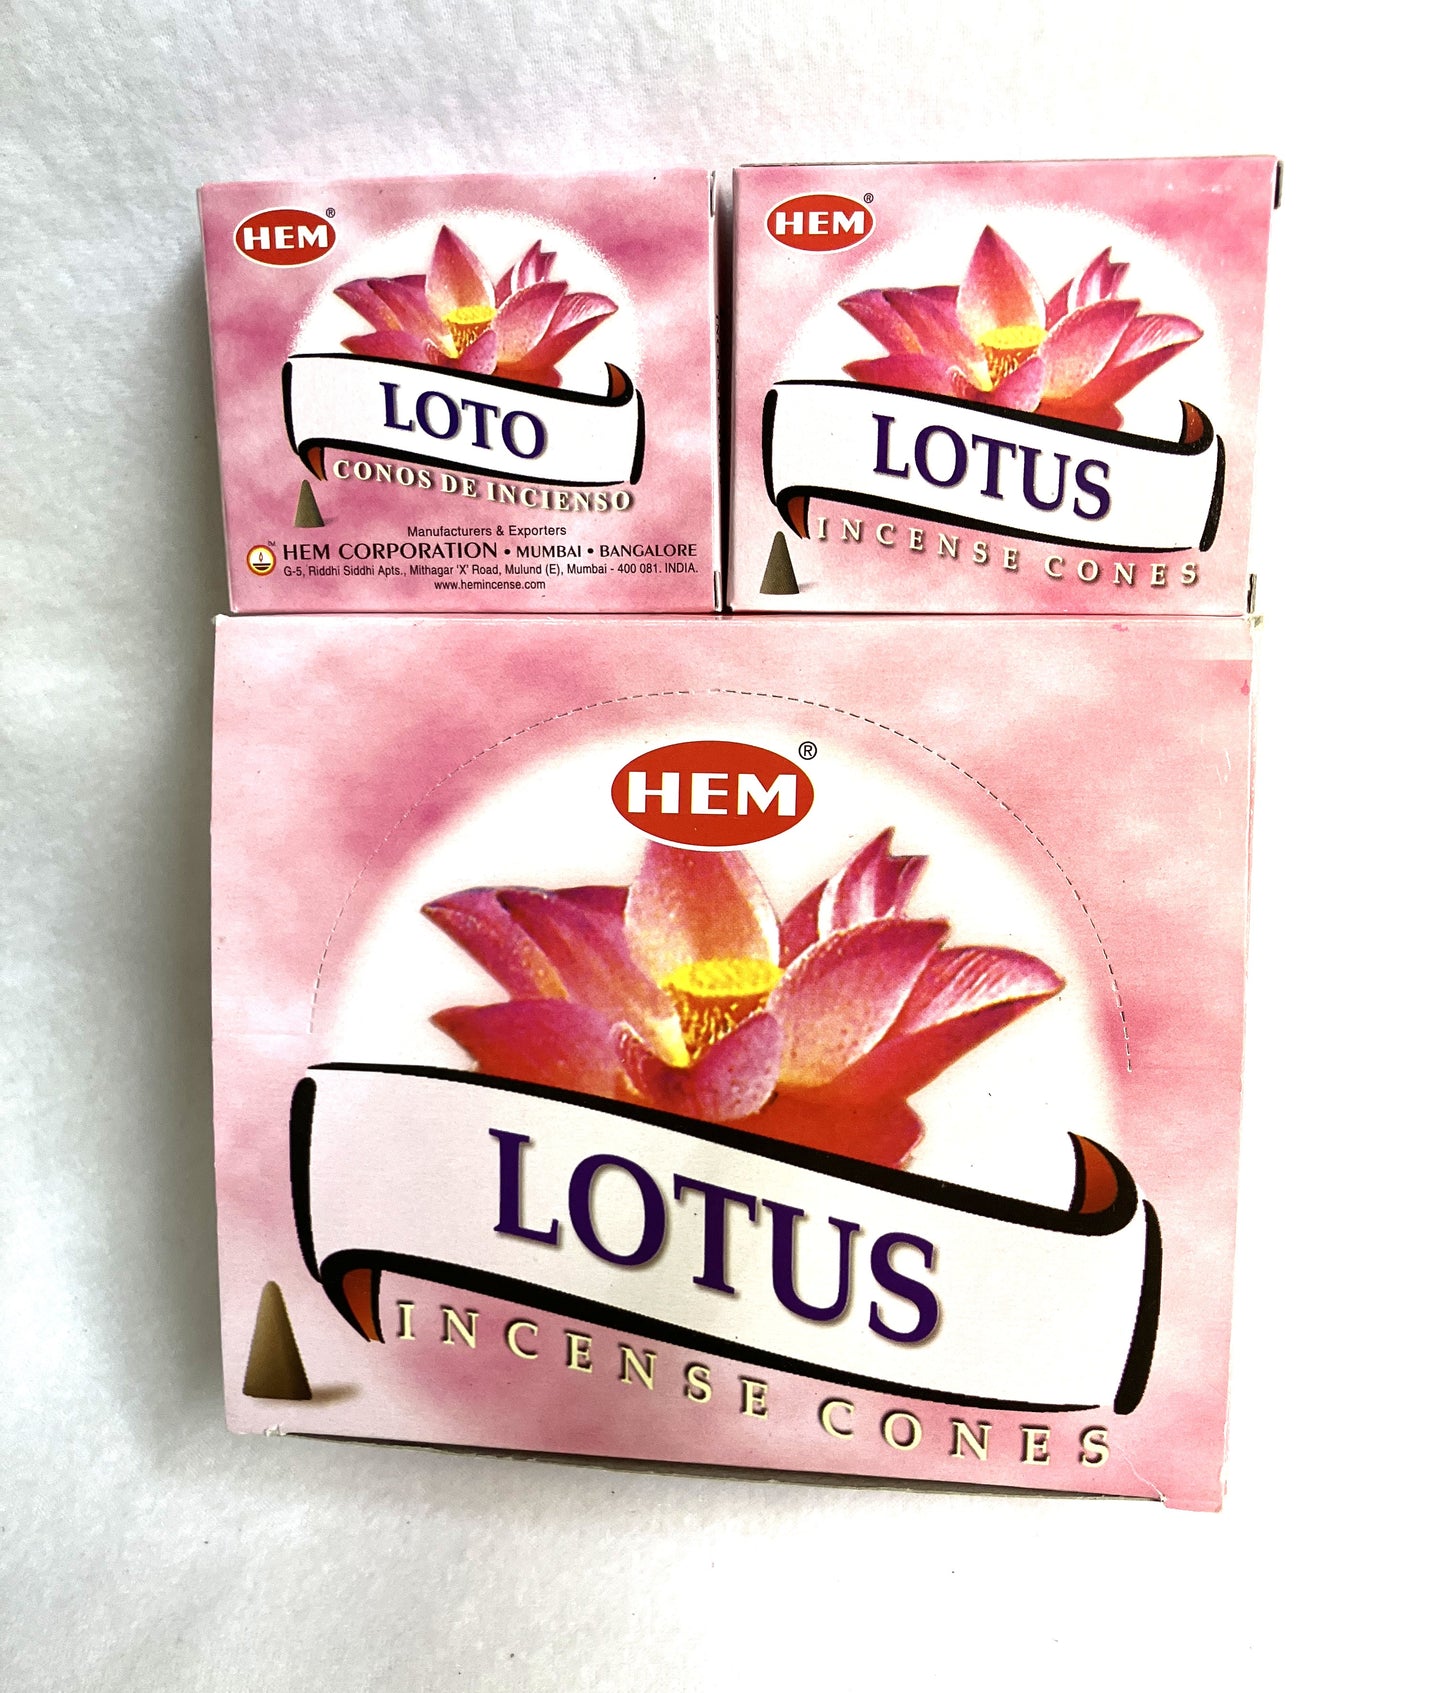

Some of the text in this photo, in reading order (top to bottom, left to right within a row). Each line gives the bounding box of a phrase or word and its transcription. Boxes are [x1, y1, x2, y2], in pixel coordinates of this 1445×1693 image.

[243, 224, 329, 250] HEM
[775, 211, 865, 235] HEM
[379, 381, 548, 460] LOTO
[332, 460, 633, 512] CONOS DE INCIENSO
[872, 414, 1112, 521] LOTUS
[283, 541, 697, 560] HEM CORPORATION MUMBAI BANGALORE
[407, 525, 567, 538] Manufacturers & Exporters
[816, 517, 1201, 588] INCENSE CONES
[283, 566, 306, 577] G-5,
[309, 564, 340, 576] Riddhi
[343, 564, 375, 576] Siddhi
[378, 564, 406, 578] Apts.,
[409, 564, 453, 578] Mithagar
[472, 564, 502, 576] Road,
[505, 563, 542, 575] Mulund
[545, 563, 564, 577] (E),
[567, 562, 607, 574] Mumbai
[617, 562, 637, 573] 400
[639, 561, 662, 573] 081.
[665, 561, 699, 574] INDIA.
[434, 579, 546, 590] www.hemincense.com
[627, 771, 797, 817] HEM
[488, 1127, 941, 1346] LOTUS
[397, 1301, 1112, 1469] INCENSE CONES
